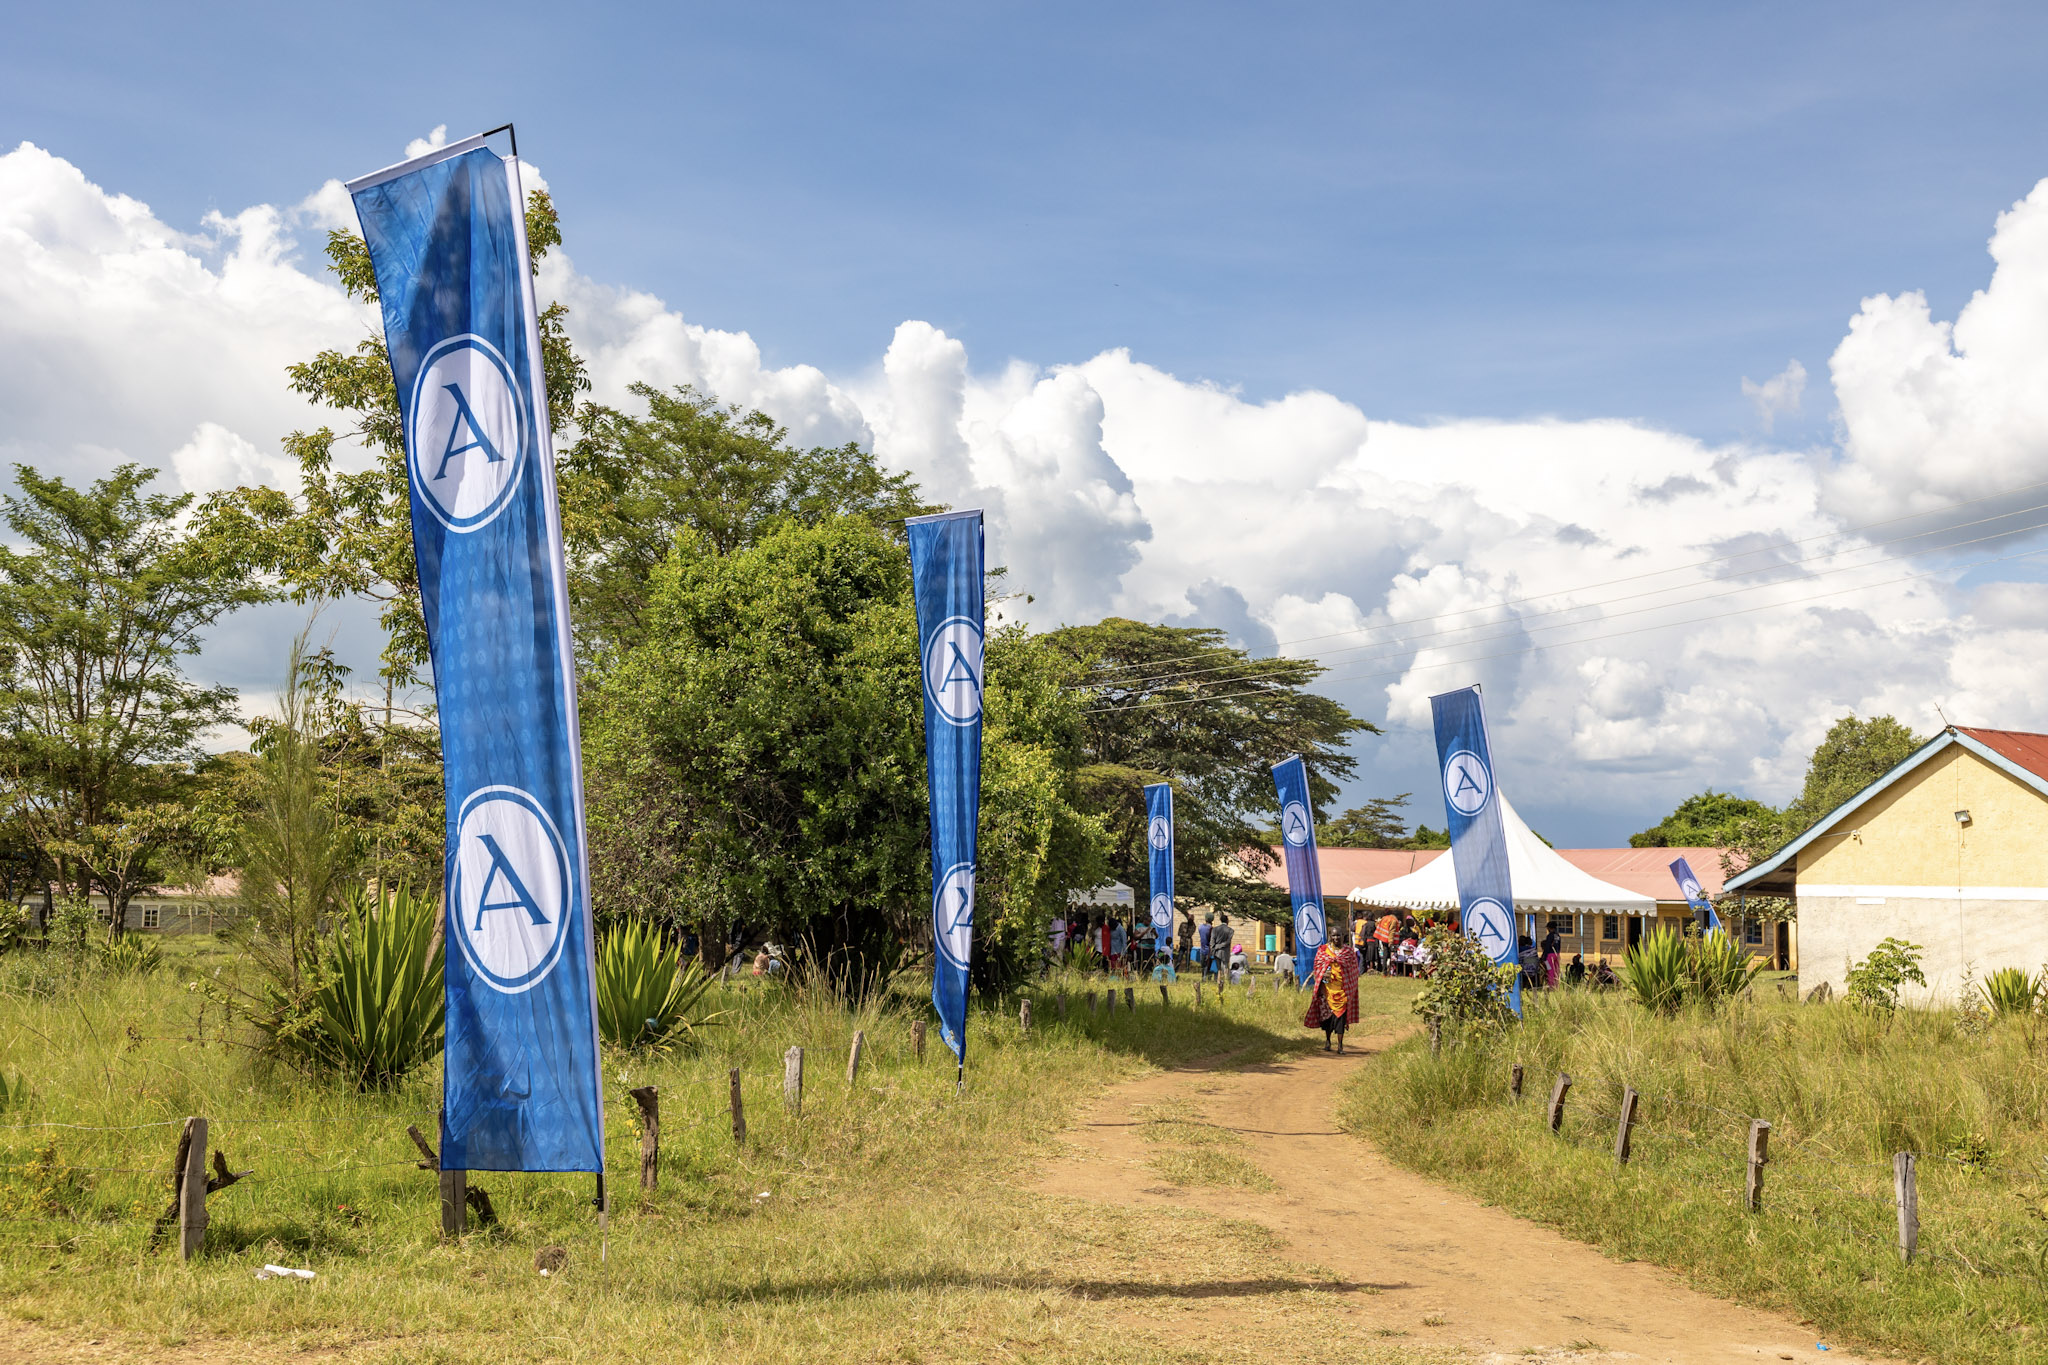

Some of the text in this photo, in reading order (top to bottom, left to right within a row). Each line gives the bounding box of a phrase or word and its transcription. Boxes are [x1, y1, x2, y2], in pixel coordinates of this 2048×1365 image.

[434, 383, 506, 481] A
[939, 641, 980, 692] A
[1454, 766, 1483, 797] A
[1153, 823, 1166, 840] A
[1289, 811, 1306, 833] A
[474, 834, 551, 932] A
[1686, 884, 1698, 896] A
[1154, 900, 1170, 917] A
[1302, 913, 1320, 935] A
[1478, 912, 1505, 941] A
